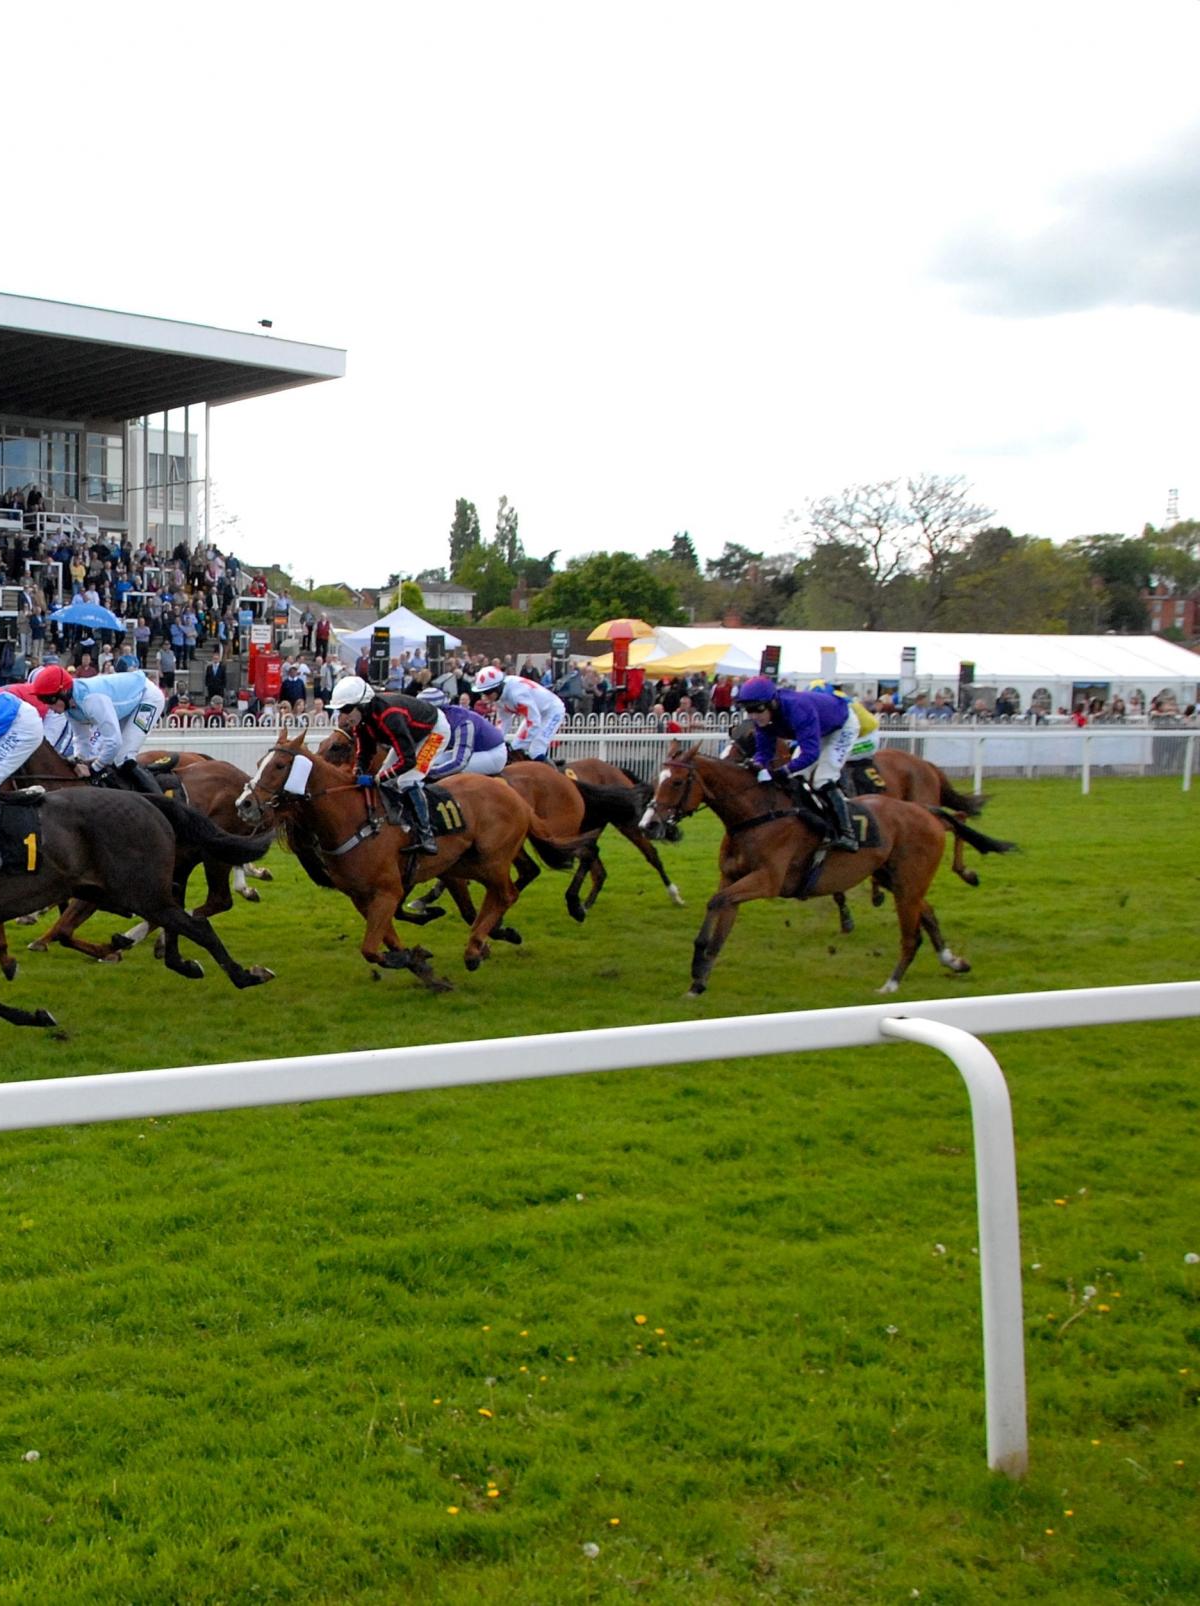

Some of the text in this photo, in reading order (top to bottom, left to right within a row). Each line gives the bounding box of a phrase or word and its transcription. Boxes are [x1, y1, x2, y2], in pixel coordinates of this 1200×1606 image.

[864, 767, 886, 788] 5
[436, 800, 462, 830] 11
[852, 814, 869, 842] 7
[23, 832, 37, 871] 1
